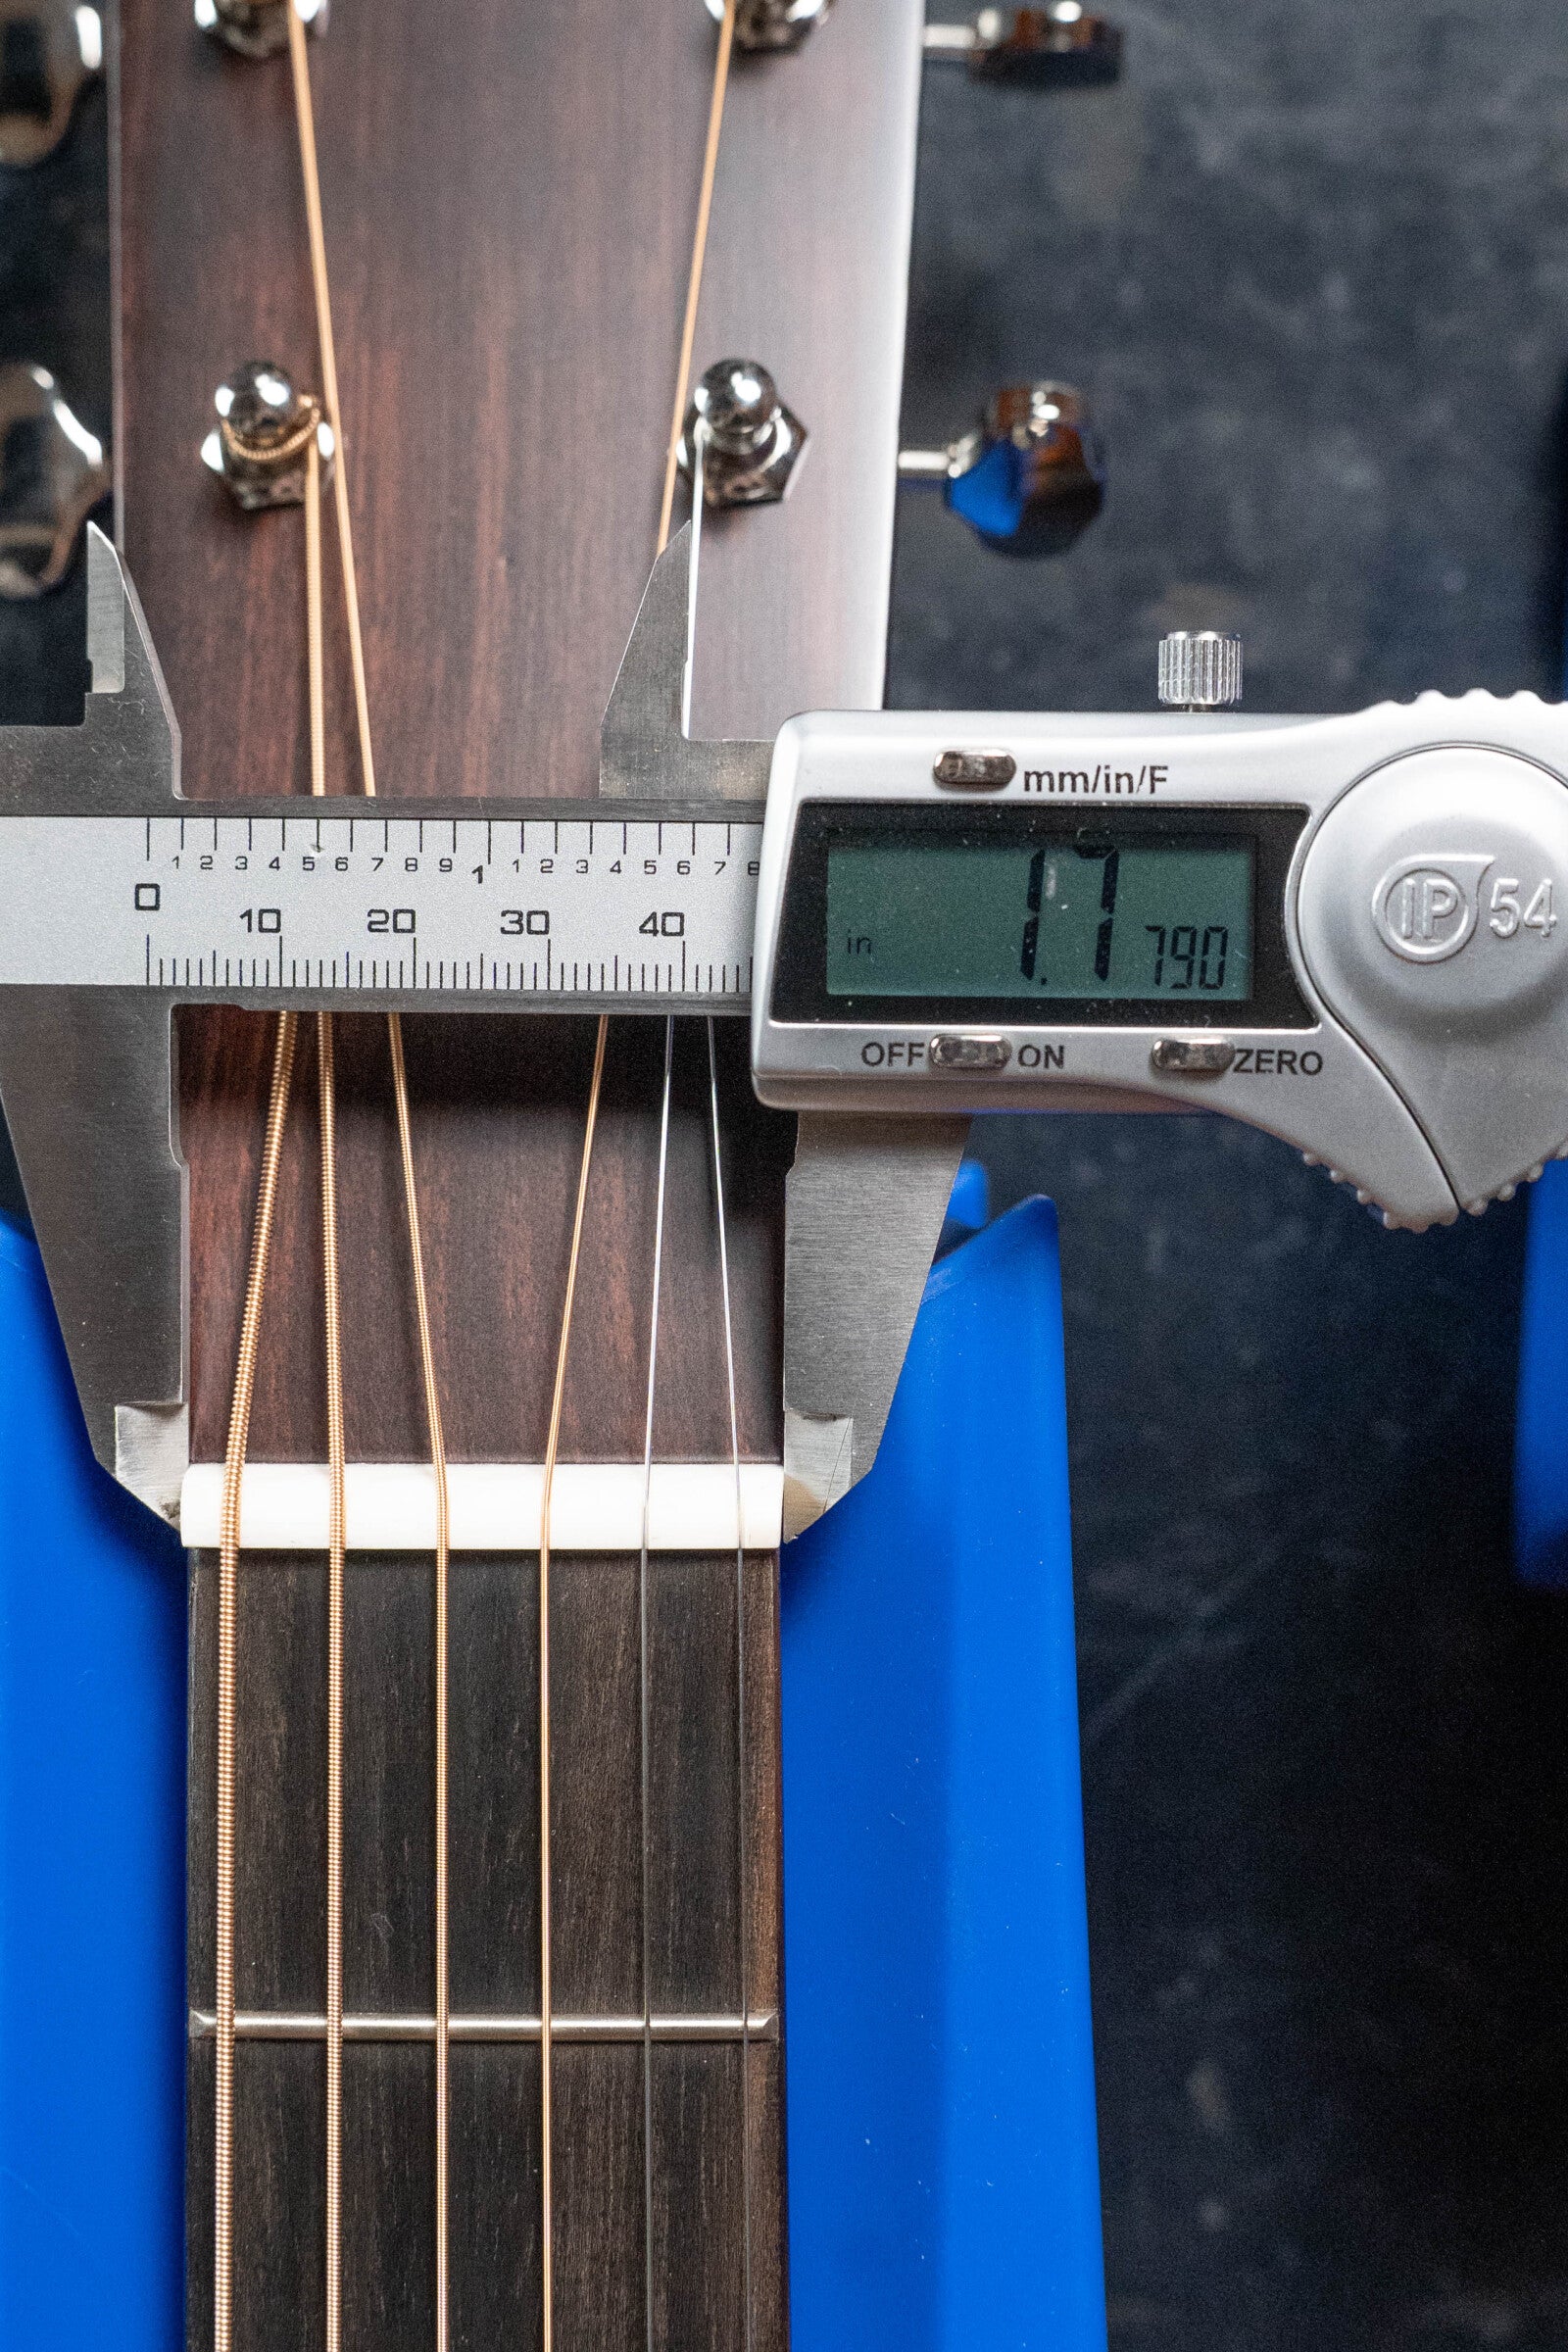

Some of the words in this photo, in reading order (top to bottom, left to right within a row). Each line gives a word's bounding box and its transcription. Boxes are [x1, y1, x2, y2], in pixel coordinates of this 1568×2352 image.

[1024, 764, 1168, 795] mm/in/F
[172, 856, 180, 870] 1
[200, 856, 214, 870] 2
[235, 856, 248, 870] 3
[269, 856, 281, 871] 4
[303, 856, 316, 871] 5
[335, 857, 349, 872] 6
[371, 857, 384, 872] 7
[405, 857, 418, 872] 8
[439, 858, 453, 873] 9
[472, 865, 483, 884] 1
[512, 858, 519, 873] 1
[540, 858, 554, 874] 2
[575, 858, 589, 874] 3
[611, 859, 623, 875] 4
[644, 859, 657, 875] 5
[677, 860, 691, 875] 6
[713, 860, 726, 875] 7
[134, 883, 161, 911] 0
[1402, 878, 1459, 940] IP
[1489, 877, 1558, 940] 54
[239, 908, 282, 934] 10
[368, 908, 416, 935] 20
[500, 909, 550, 936] 30
[638, 911, 685, 937] 40
[846, 930, 873, 956] in
[859, 1041, 925, 1068] OFF
[1016, 1043, 1065, 1070] ON
[1232, 1046, 1324, 1077] ZERO
